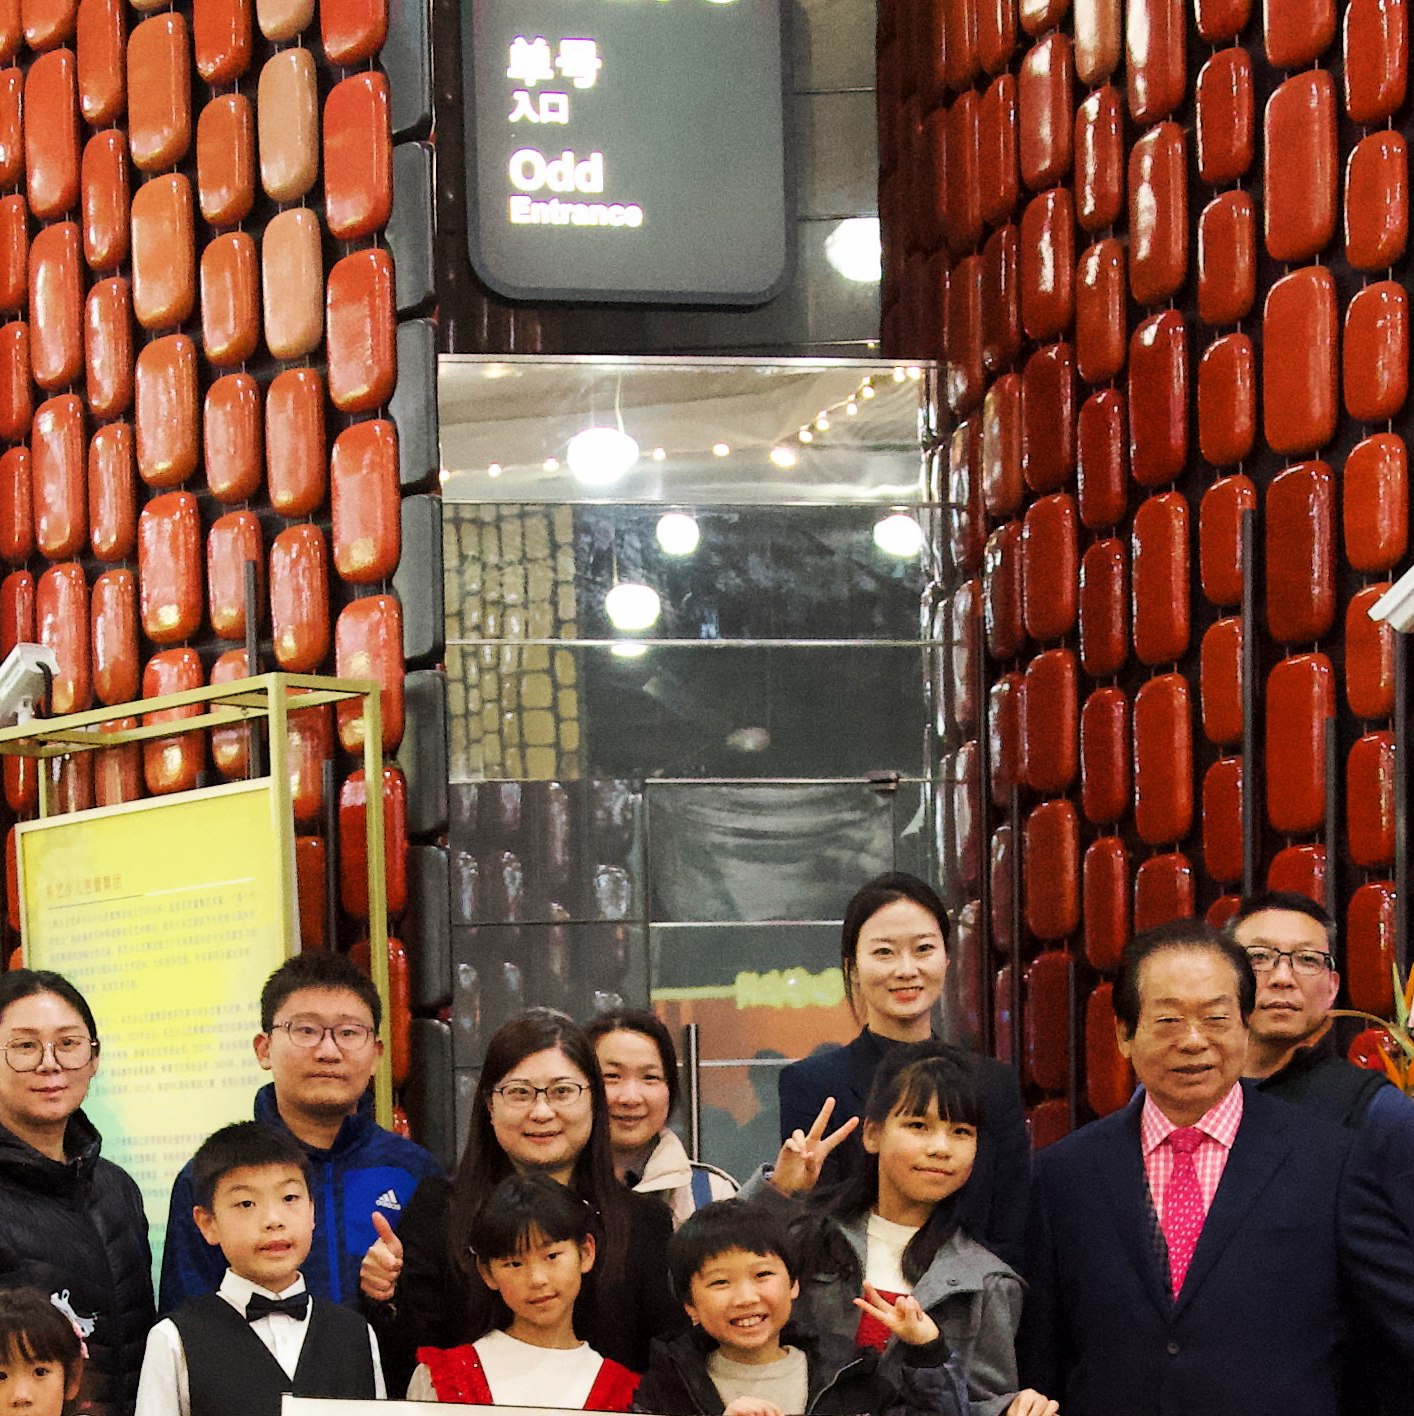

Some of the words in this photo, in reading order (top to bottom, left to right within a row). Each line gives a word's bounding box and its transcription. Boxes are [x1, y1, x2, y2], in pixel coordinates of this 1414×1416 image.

[508, 89, 570, 124] 入口
[508, 147, 605, 193] Odd
[508, 194, 644, 227] Entrance
